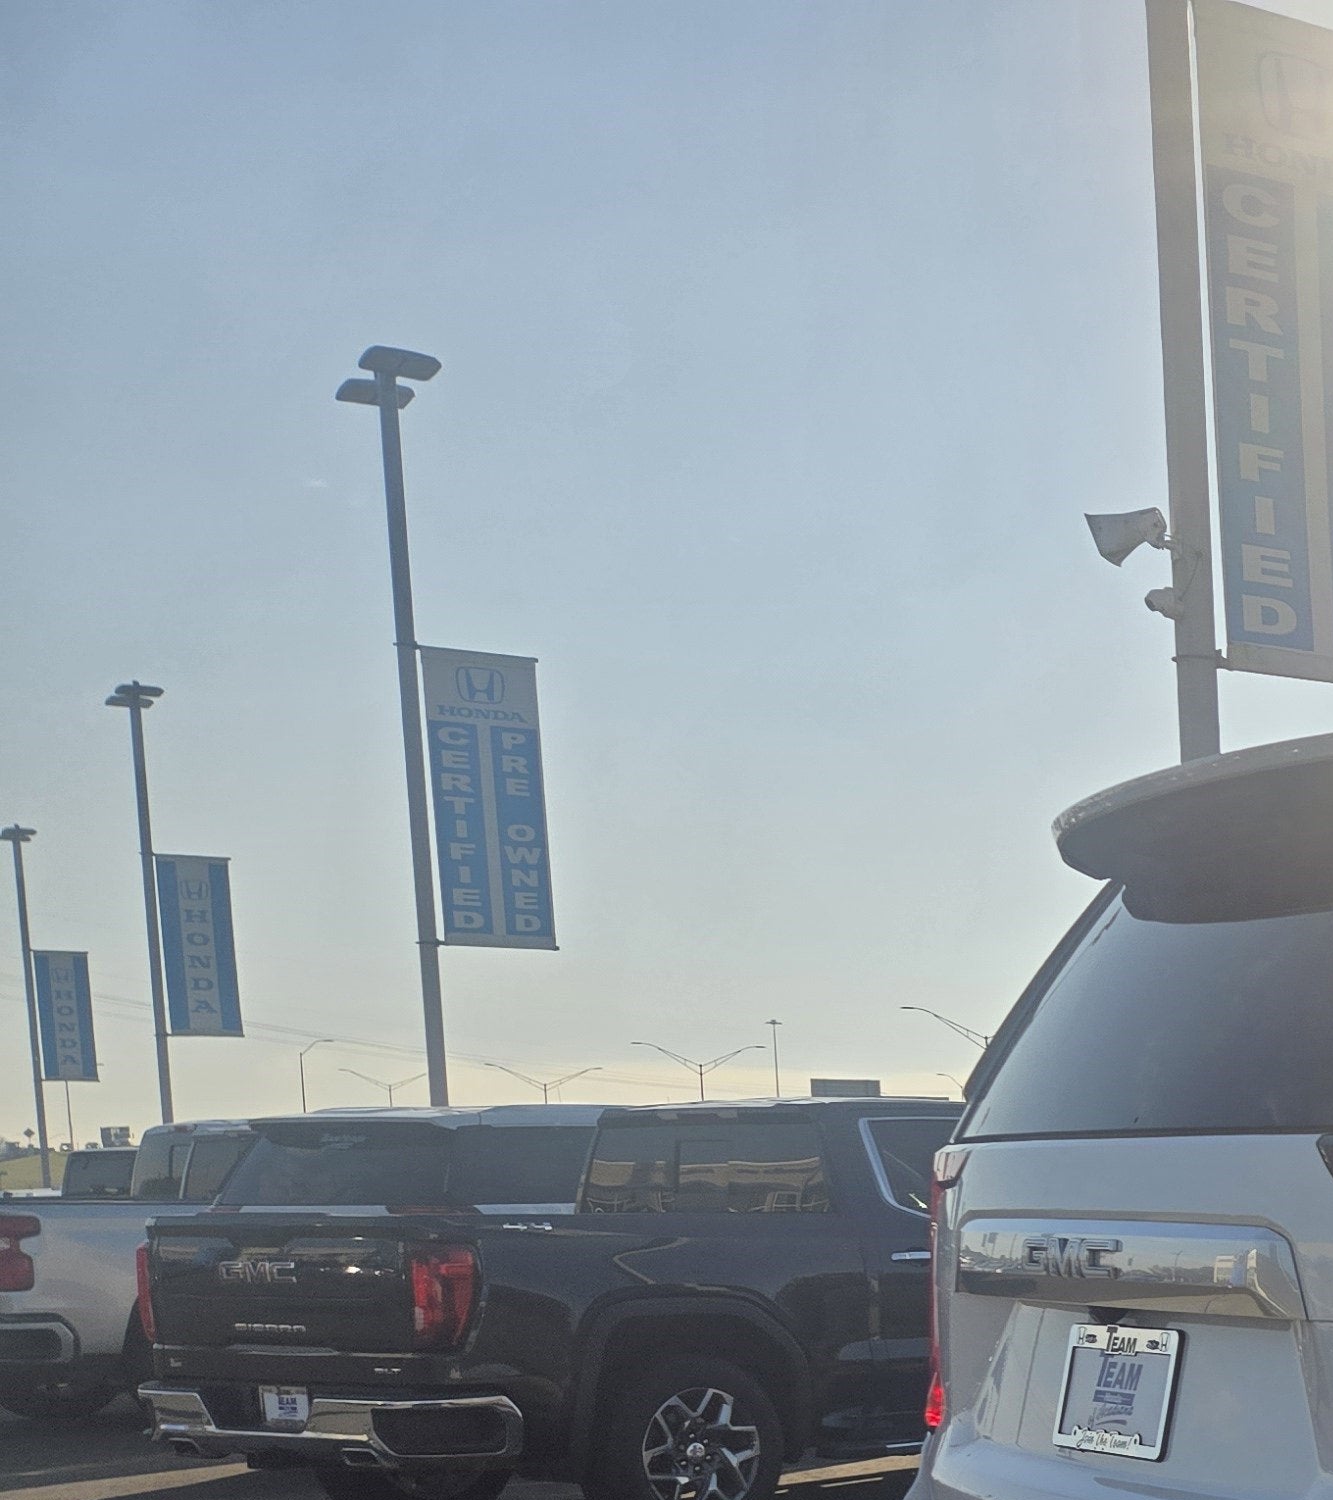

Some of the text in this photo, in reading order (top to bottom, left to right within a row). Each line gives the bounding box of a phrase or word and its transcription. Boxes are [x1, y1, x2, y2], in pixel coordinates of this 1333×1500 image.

[1222, 182, 1298, 638] CERTIFIED
[437, 703, 529, 724] HONDA
[438, 726, 486, 931] CERTIFIED
[501, 732, 542, 933] PRE OWNED
[184, 908, 218, 1014] HONDA
[54, 989, 81, 1066] HONDA
[218, 1260, 297, 1283] GMC
[1022, 1236, 1124, 1280] GMC
[1105, 1325, 1138, 1354] TEAM
[1096, 1352, 1144, 1392] TEAM
